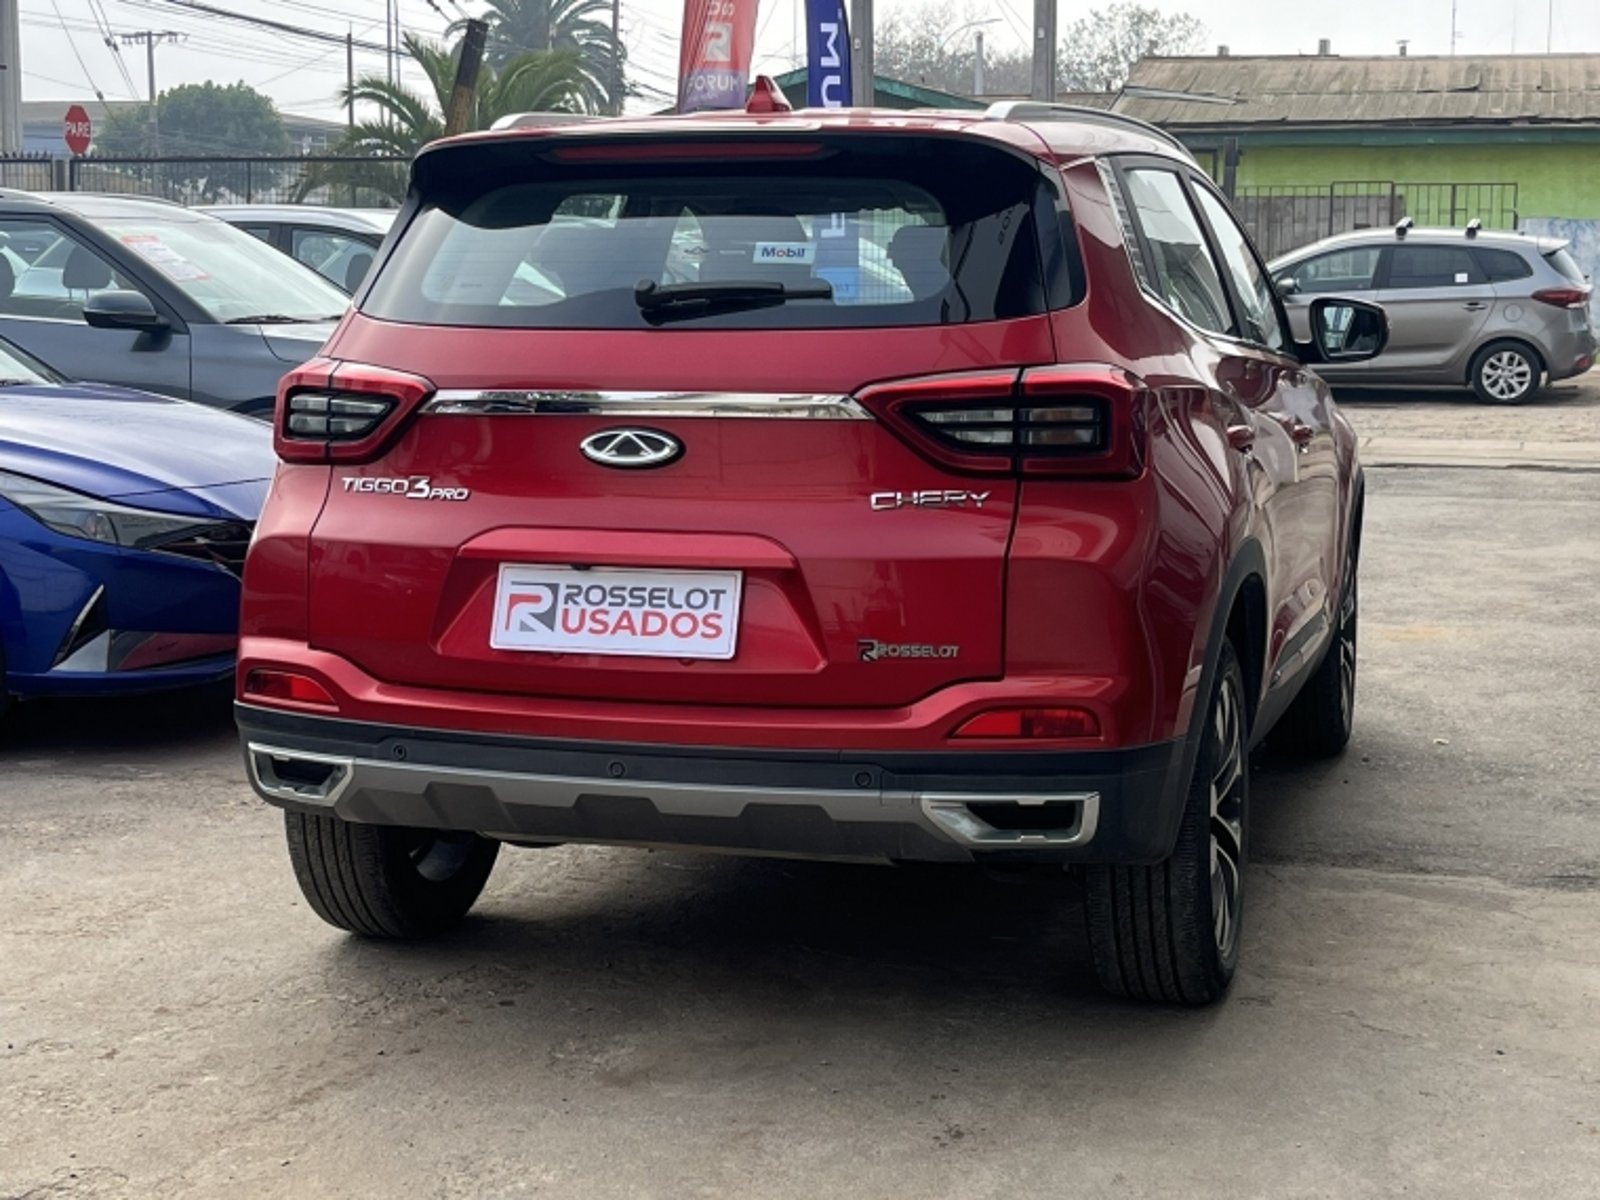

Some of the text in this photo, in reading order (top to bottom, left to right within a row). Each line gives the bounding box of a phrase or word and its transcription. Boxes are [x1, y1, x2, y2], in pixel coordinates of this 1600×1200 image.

[66, 121, 90, 138] PARE
[761, 246, 805, 258] Mobil
[870, 490, 991, 510] CHERY
[563, 584, 727, 610] ROSSELOT
[561, 608, 723, 639] USADOS
[877, 644, 959, 658] ROSSELOT
